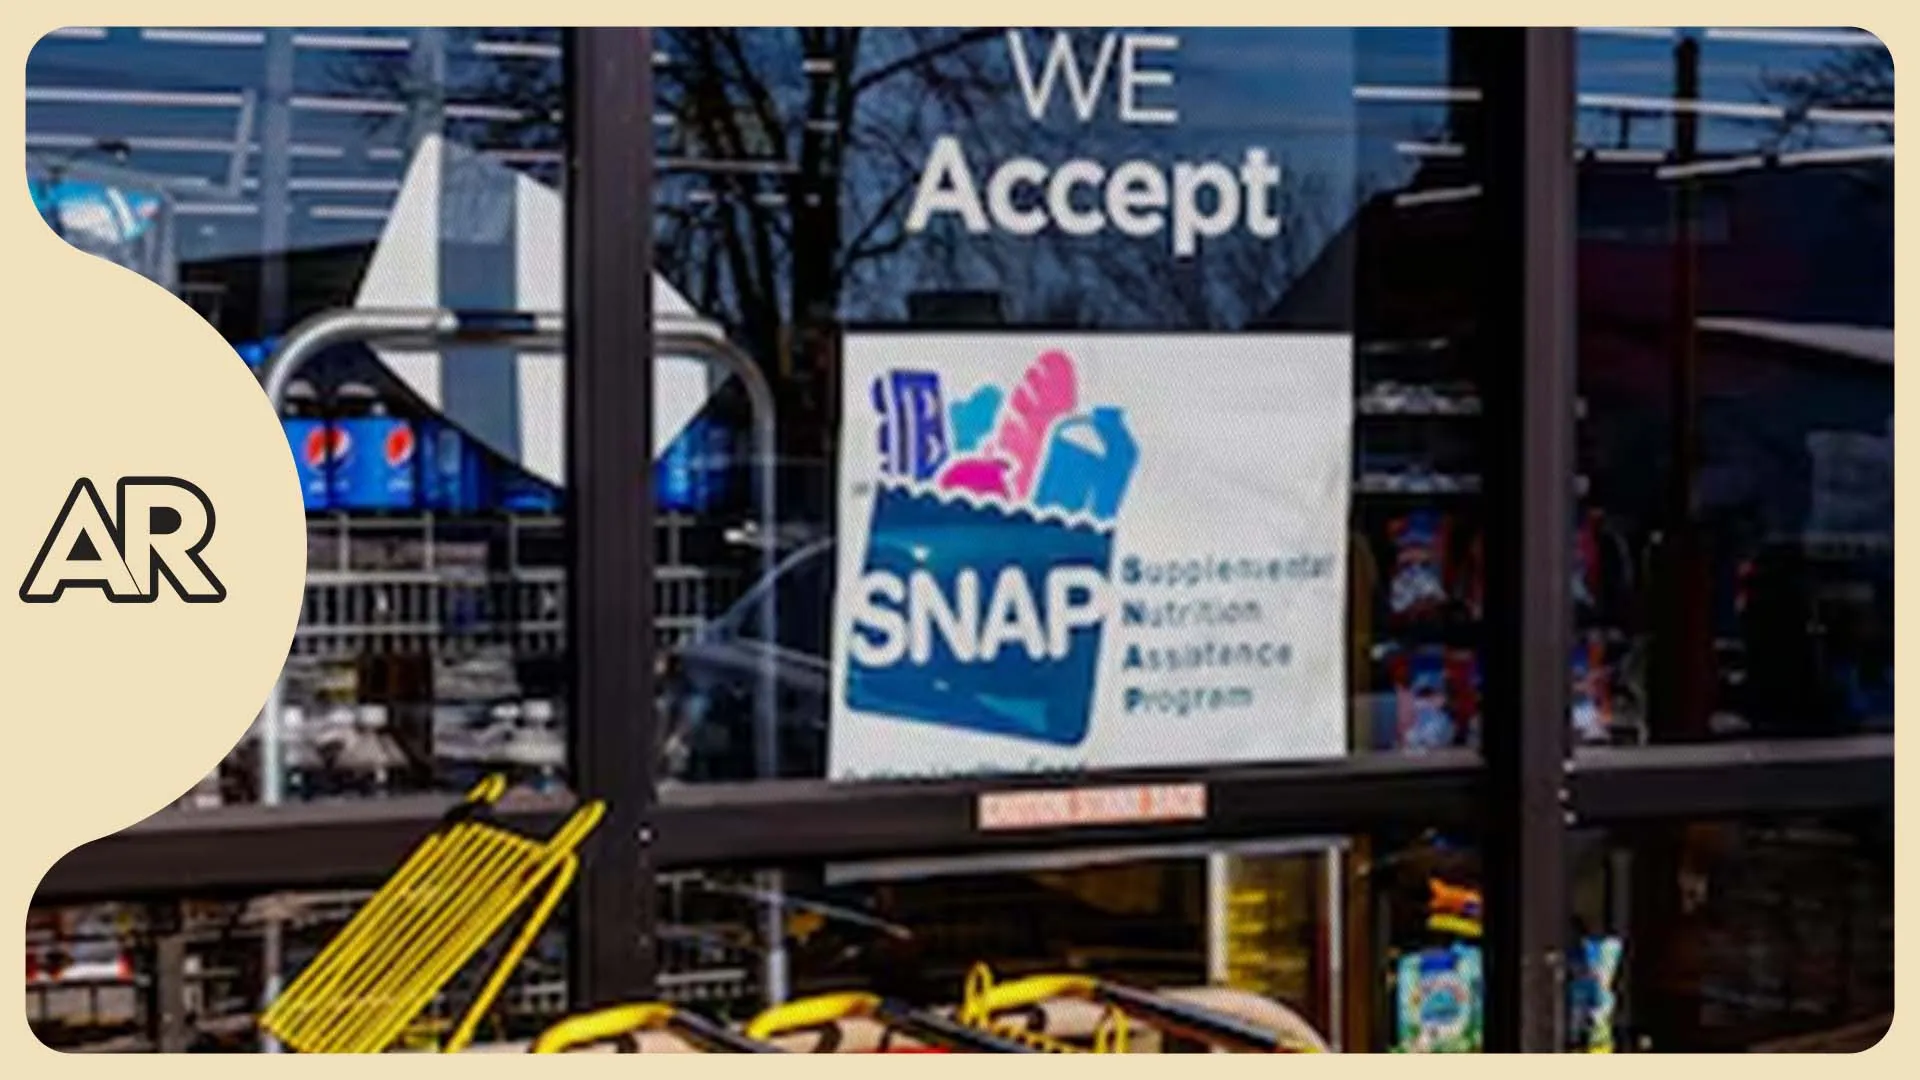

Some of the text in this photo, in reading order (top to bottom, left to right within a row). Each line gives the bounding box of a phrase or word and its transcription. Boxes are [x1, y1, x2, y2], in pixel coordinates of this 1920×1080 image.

[1006, 31, 1180, 123] WE
[905, 135, 1281, 256] Accept
[847, 566, 1112, 668] SNAP
[1121, 600, 1261, 627] Nutrition
[1123, 686, 1253, 716] Program
